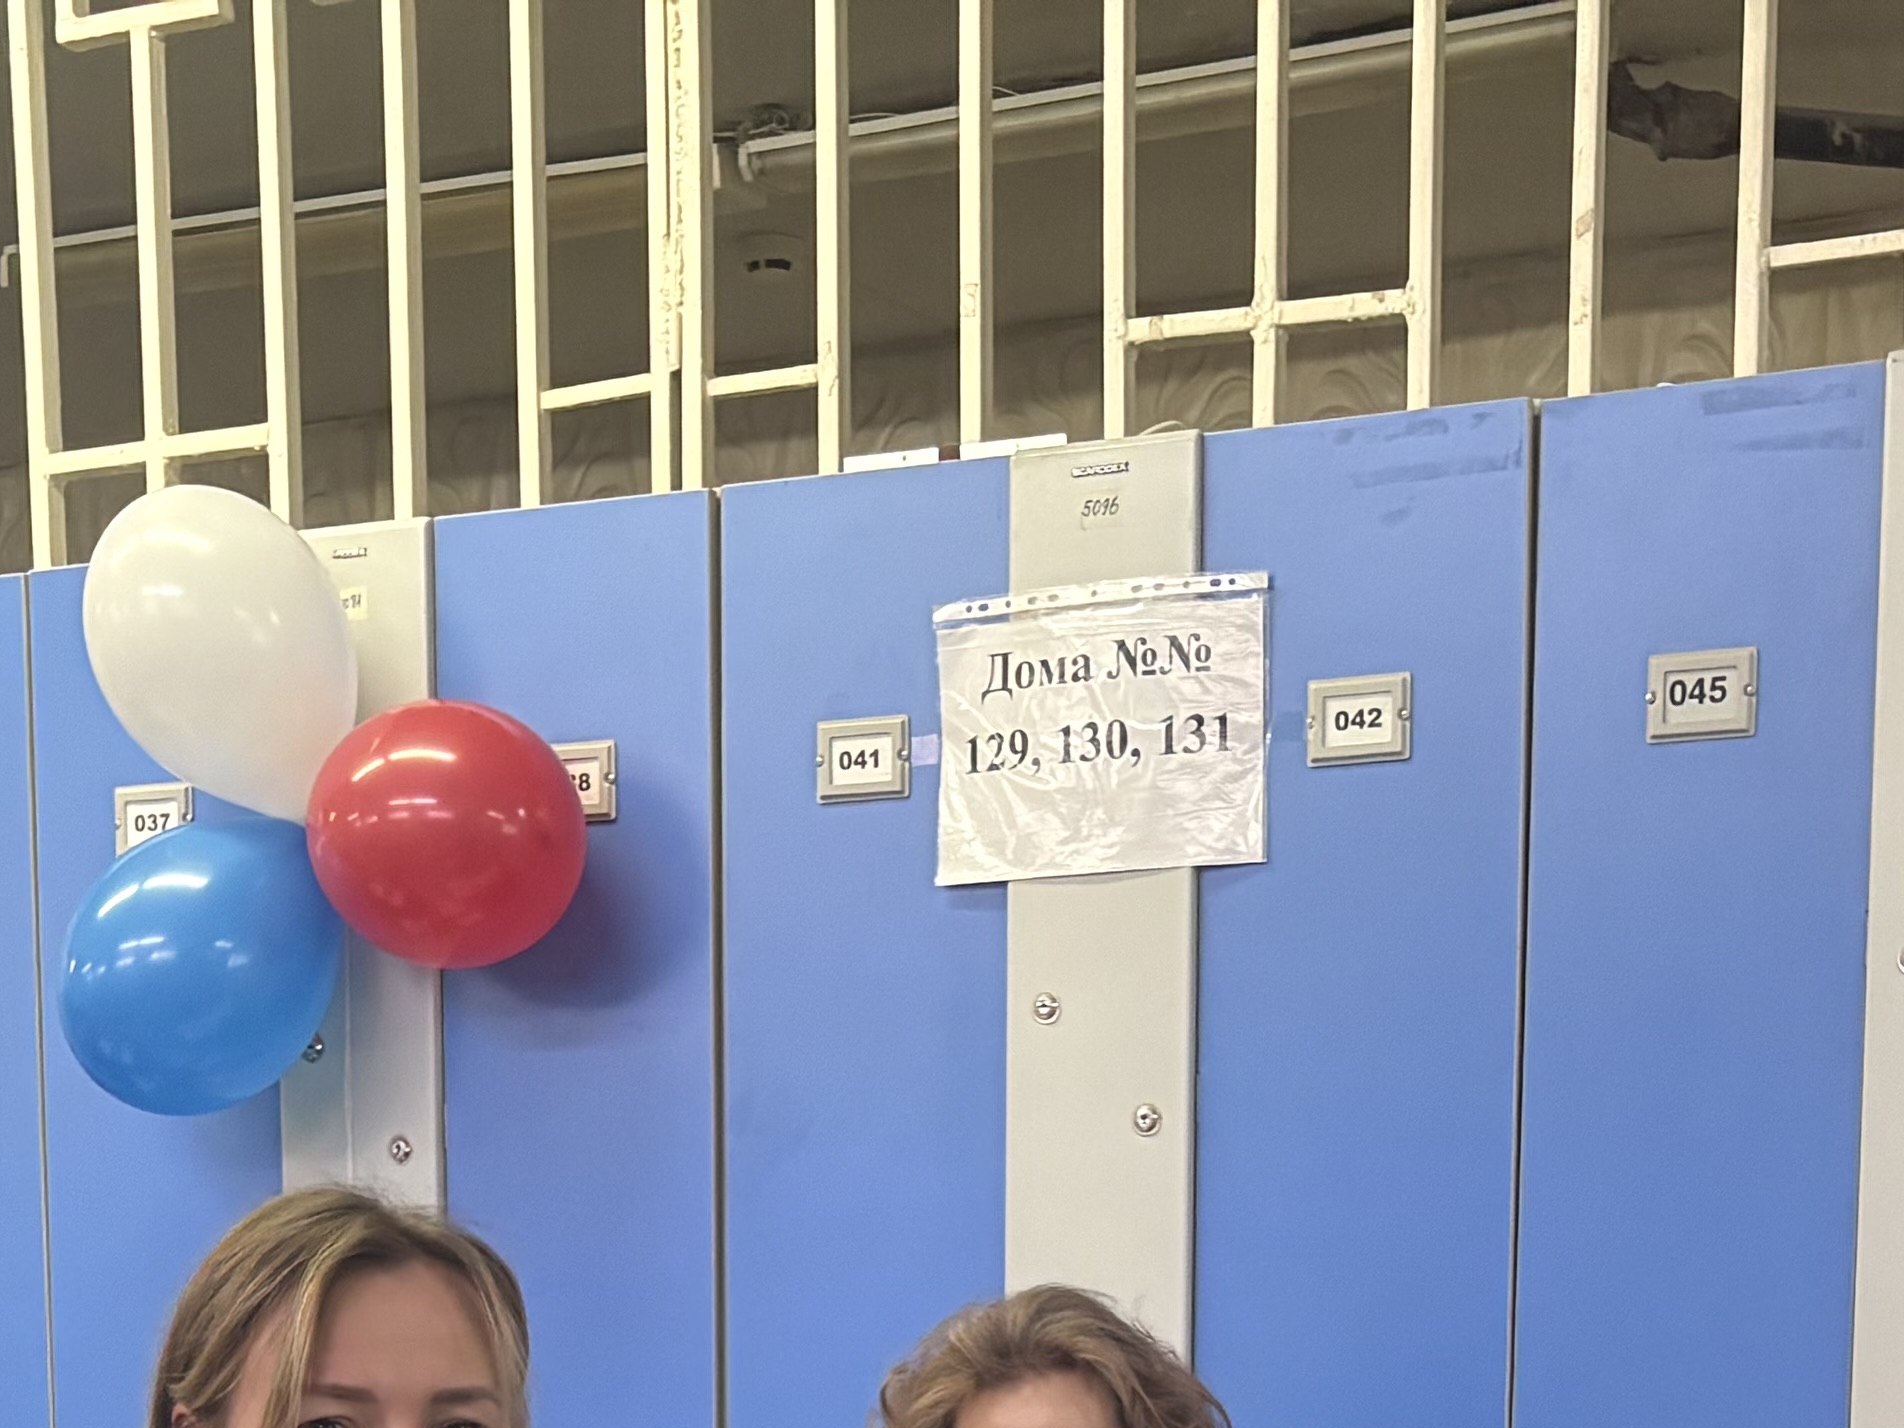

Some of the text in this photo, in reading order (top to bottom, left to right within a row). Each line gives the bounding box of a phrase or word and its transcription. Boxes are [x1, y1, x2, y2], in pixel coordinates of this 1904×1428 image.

[979, 649, 1093, 704] Дома
[1668, 676, 1728, 707] 045
[1334, 708, 1383, 732] 042
[965, 711, 1232, 775] 129, 130, 131
[839, 749, 880, 771] 041
[571, 772, 592, 792] 8
[134, 812, 171, 832] 037
